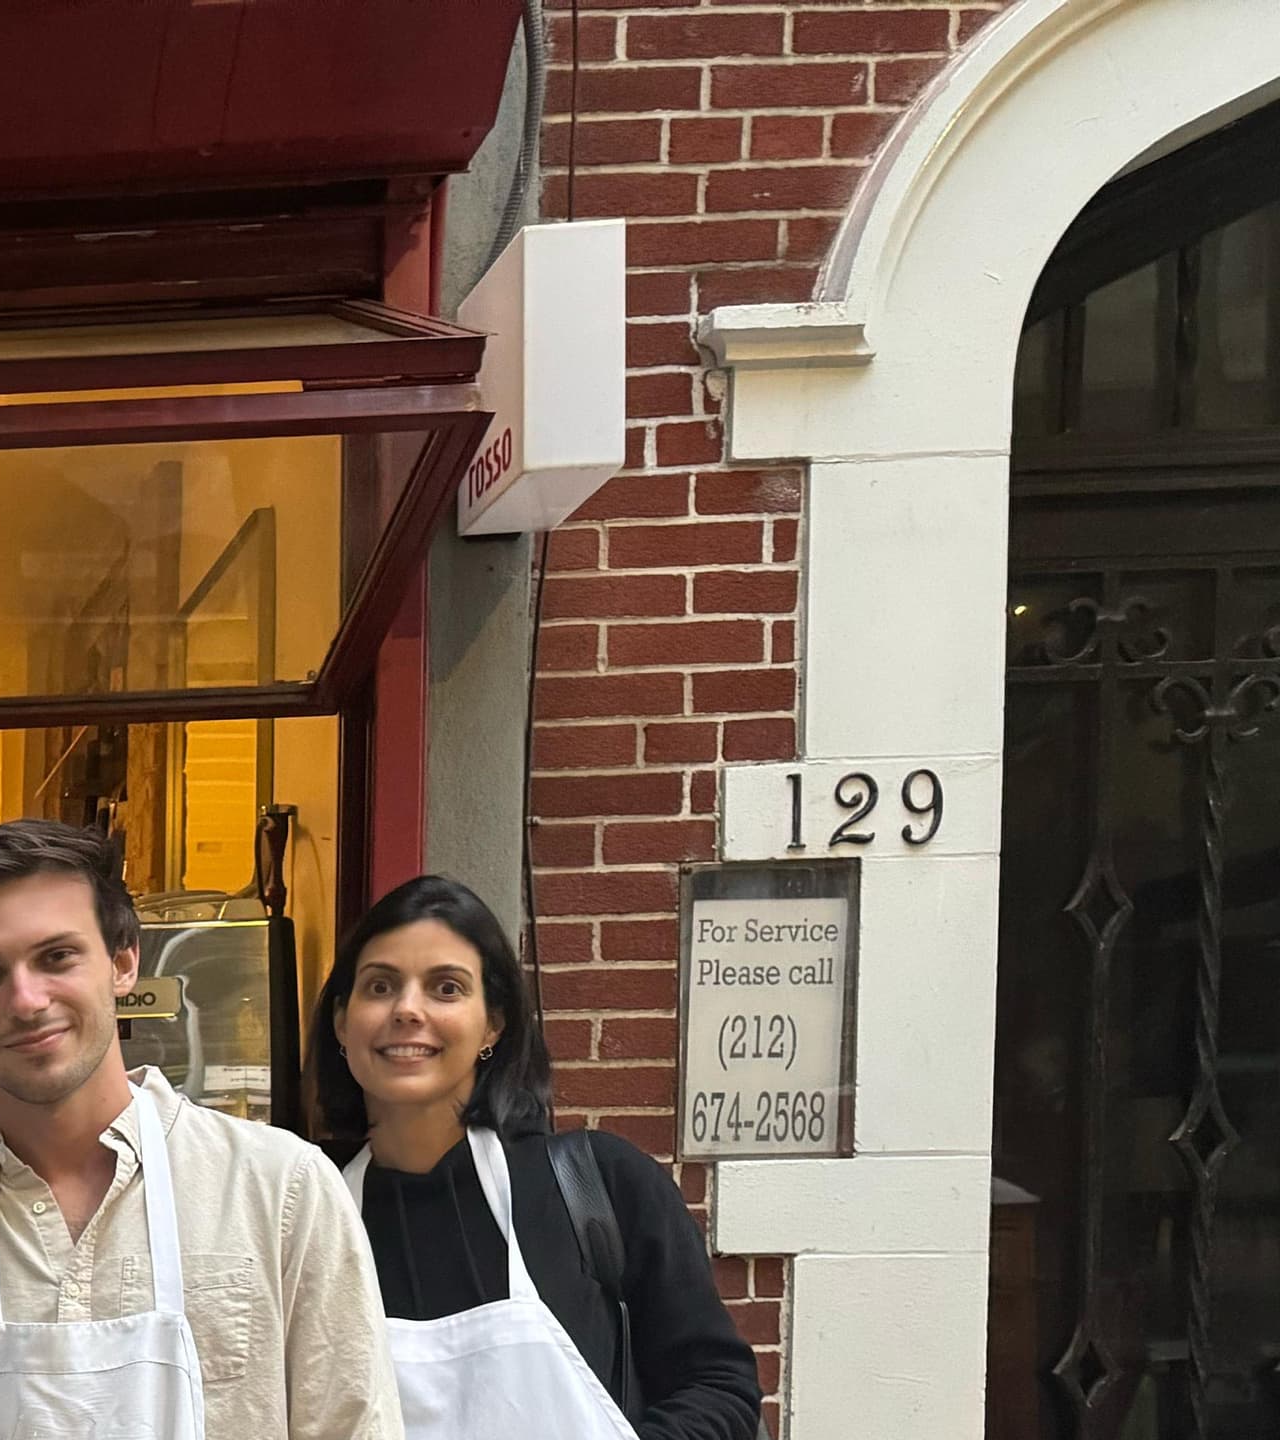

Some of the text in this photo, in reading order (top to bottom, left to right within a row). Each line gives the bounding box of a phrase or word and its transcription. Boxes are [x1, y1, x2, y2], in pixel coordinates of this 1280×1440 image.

[468, 427, 513, 508] rosso
[785, 768, 945, 850] 129
[696, 917, 839, 943] For Service
[696, 957, 834, 986] Please call
[717, 1014, 798, 1071] (212)
[691, 1090, 826, 1143] 674-2568
